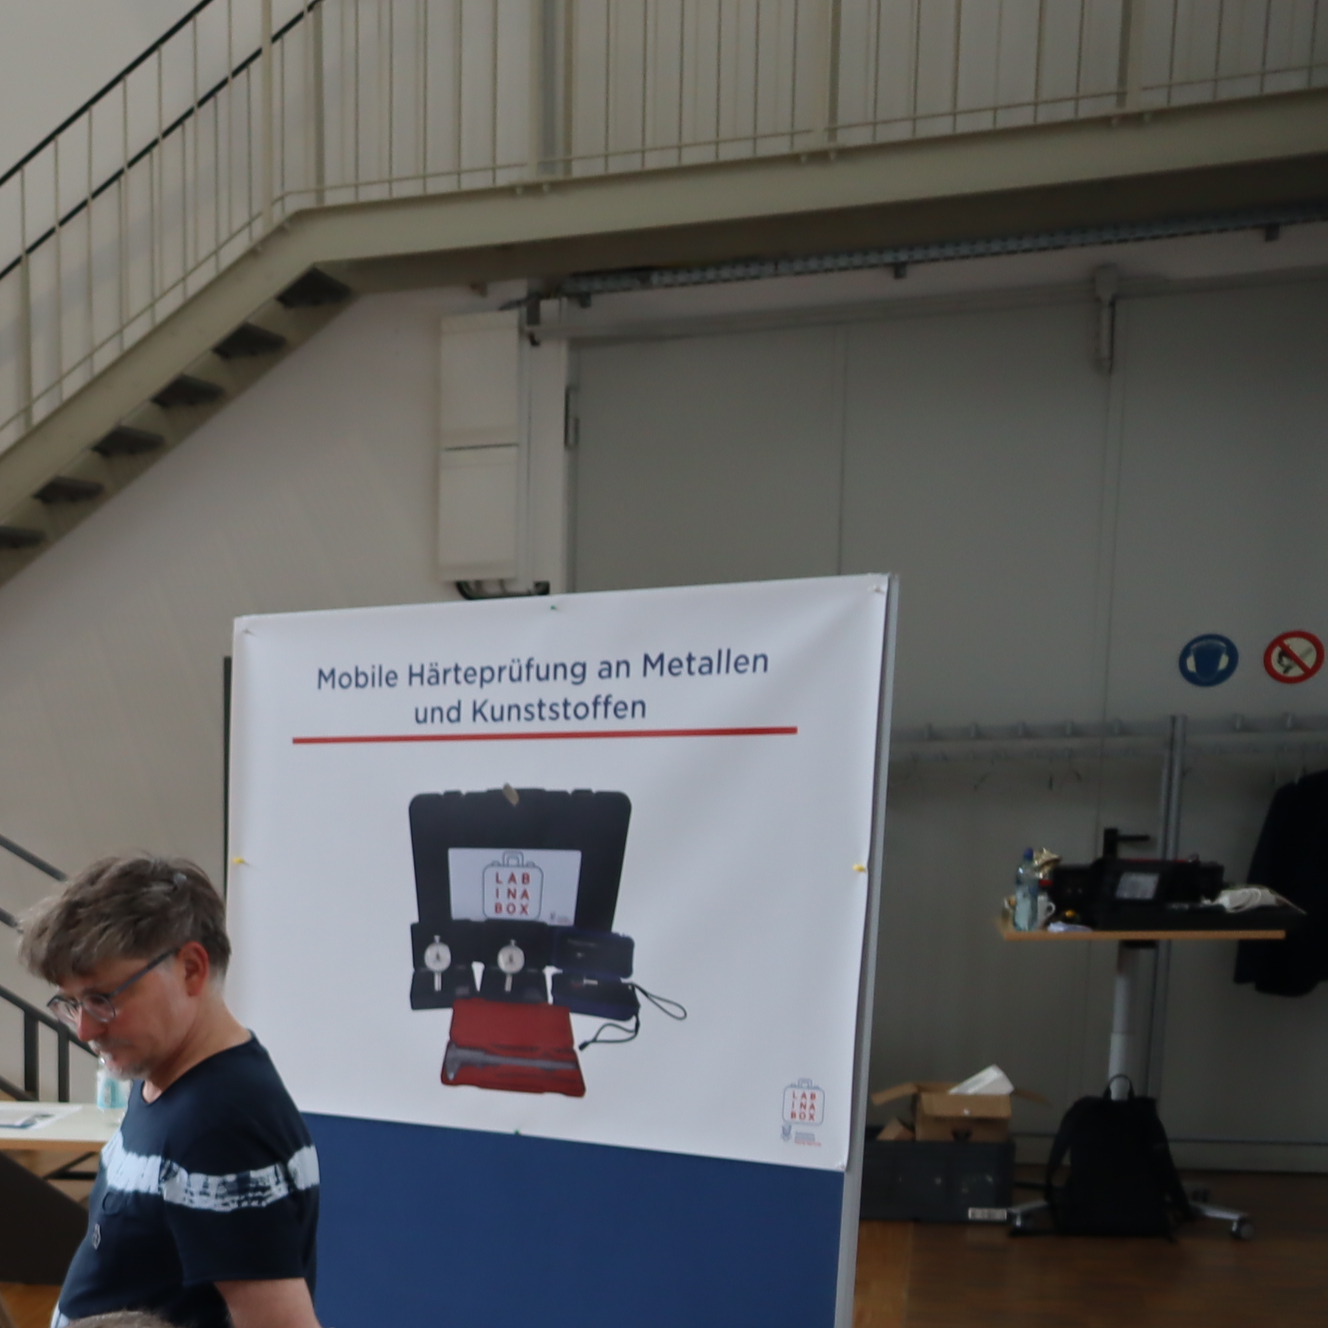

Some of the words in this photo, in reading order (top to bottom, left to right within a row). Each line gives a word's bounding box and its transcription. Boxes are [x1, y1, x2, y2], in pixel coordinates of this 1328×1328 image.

[316, 664, 399, 691] Mobile
[407, 656, 588, 690] Härteprüfung
[597, 658, 631, 681] an
[642, 647, 770, 679] Metallen
[414, 699, 462, 725] und
[471, 694, 647, 725] Kunststoffen
[495, 871, 531, 885] LAB
[494, 902, 529, 915] BOX
